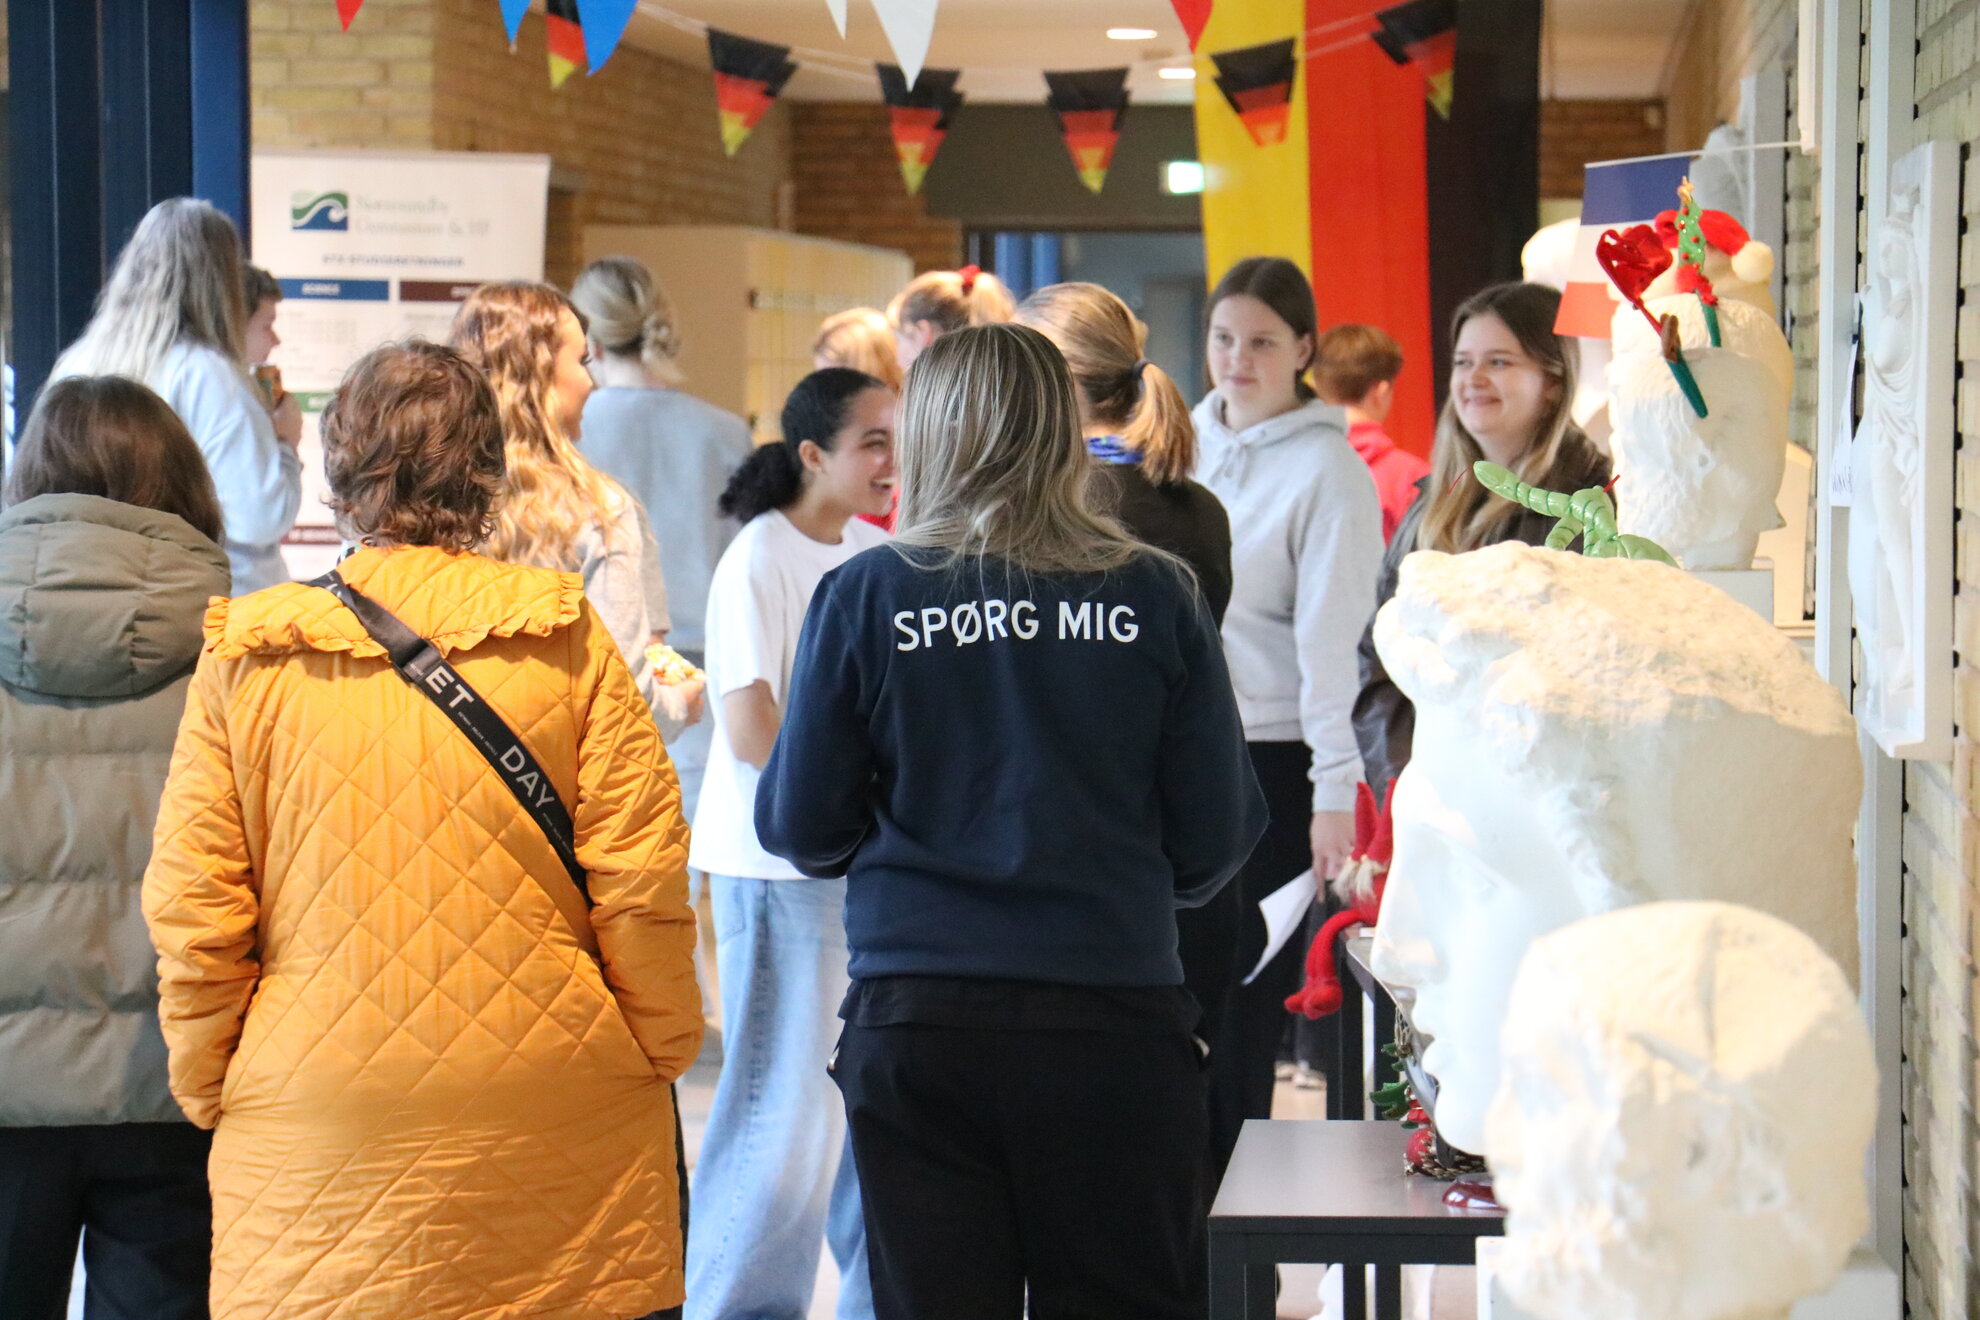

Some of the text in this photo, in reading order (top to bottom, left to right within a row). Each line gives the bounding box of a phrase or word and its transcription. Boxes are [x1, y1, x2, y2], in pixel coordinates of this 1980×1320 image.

[894, 599, 1139, 651] SPØRG MIG
[425, 665, 555, 808] ET DAY
